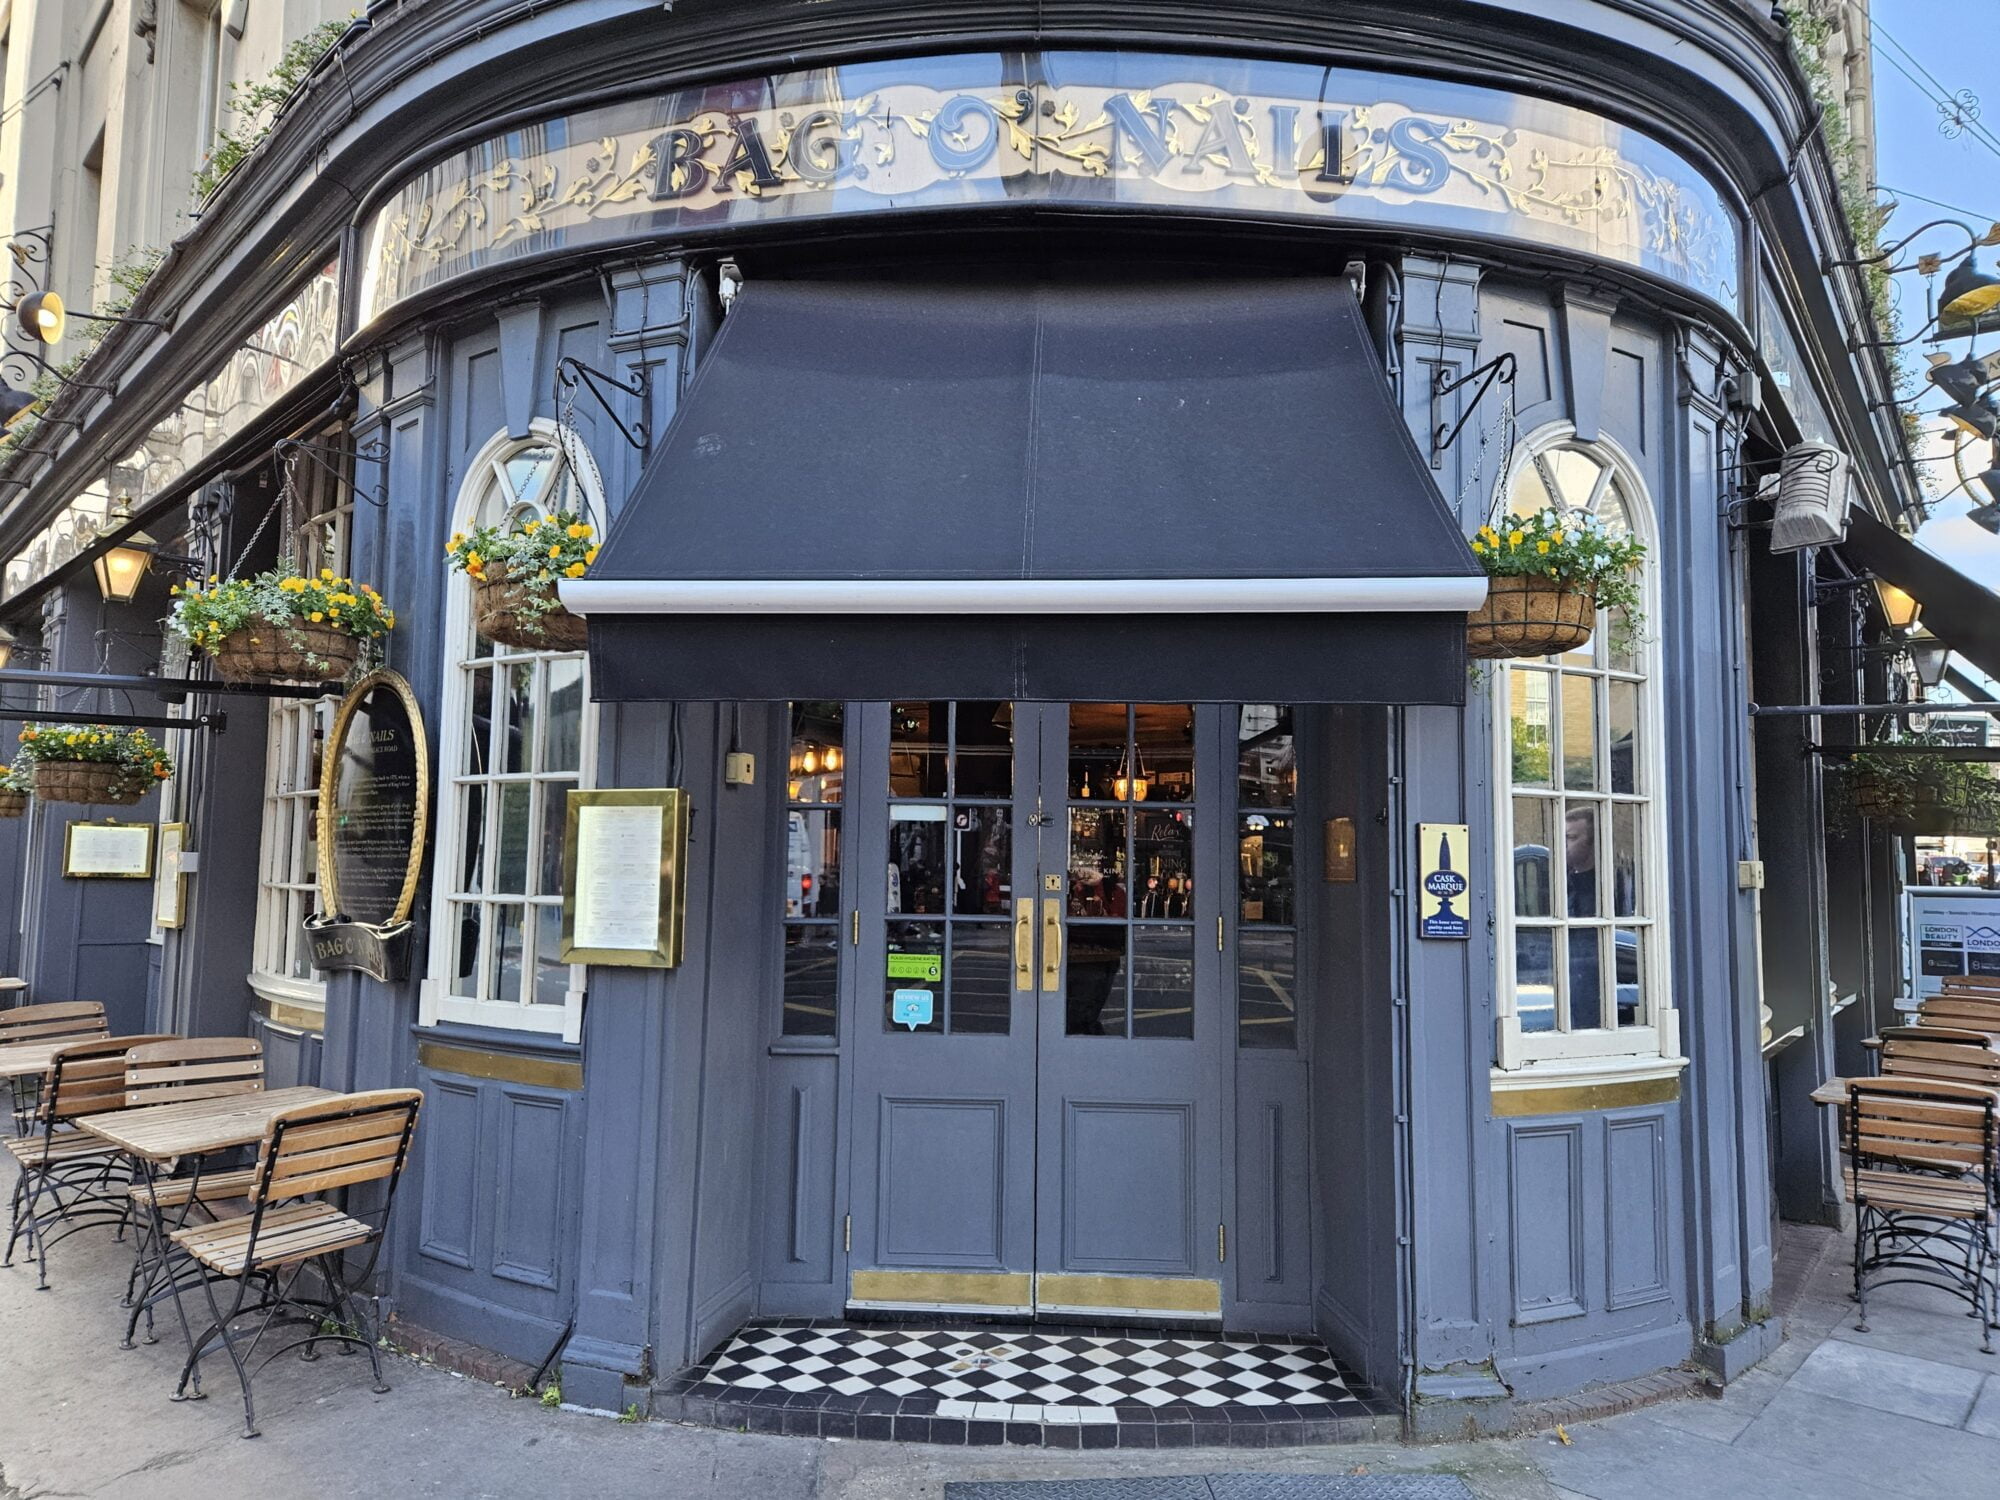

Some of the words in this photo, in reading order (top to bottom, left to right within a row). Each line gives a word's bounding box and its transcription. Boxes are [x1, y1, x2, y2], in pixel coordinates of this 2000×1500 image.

[648, 110, 858, 201] BAG
[927, 89, 1034, 172] O'
[1104, 92, 1451, 195] NAILS
[369, 728, 395, 743] NAILS
[1428, 882, 1463, 892] MARQUE
[316, 937, 344, 960] BAG
